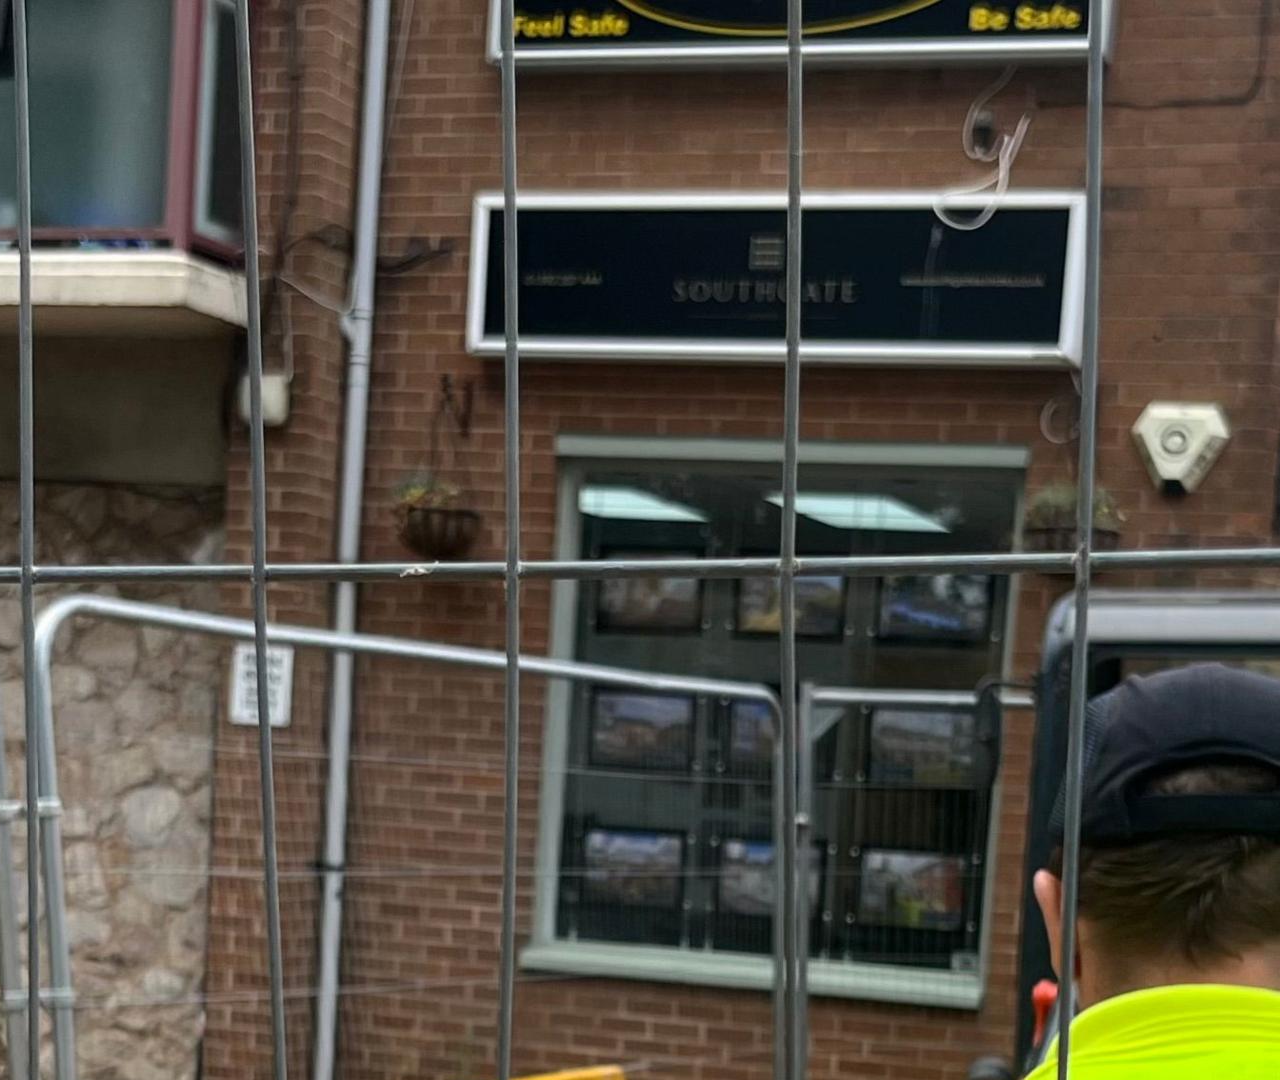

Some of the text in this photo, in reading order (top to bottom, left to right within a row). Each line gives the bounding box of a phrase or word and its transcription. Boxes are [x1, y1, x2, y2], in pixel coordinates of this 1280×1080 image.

[568, 12, 629, 37] Safe
[969, 4, 1080, 31] Be Safe
